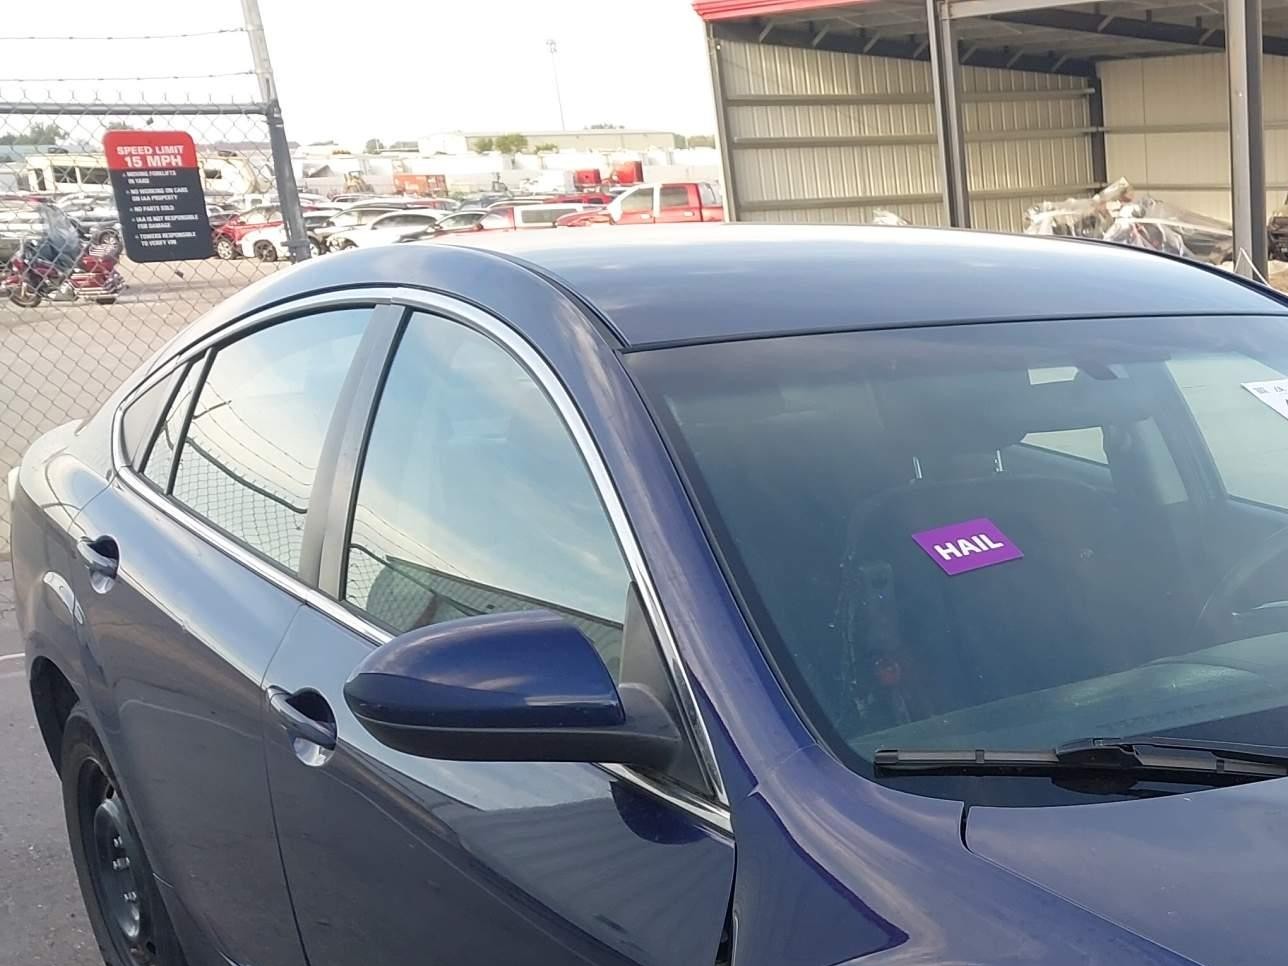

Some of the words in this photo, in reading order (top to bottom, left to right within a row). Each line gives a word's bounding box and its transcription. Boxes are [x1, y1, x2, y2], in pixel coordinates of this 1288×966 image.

[116, 146, 153, 155] SPEED
[155, 145, 184, 154] LIMIT
[124, 156, 142, 167] 15
[147, 155, 183, 167] MPH
[934, 533, 1005, 561] HAIL
